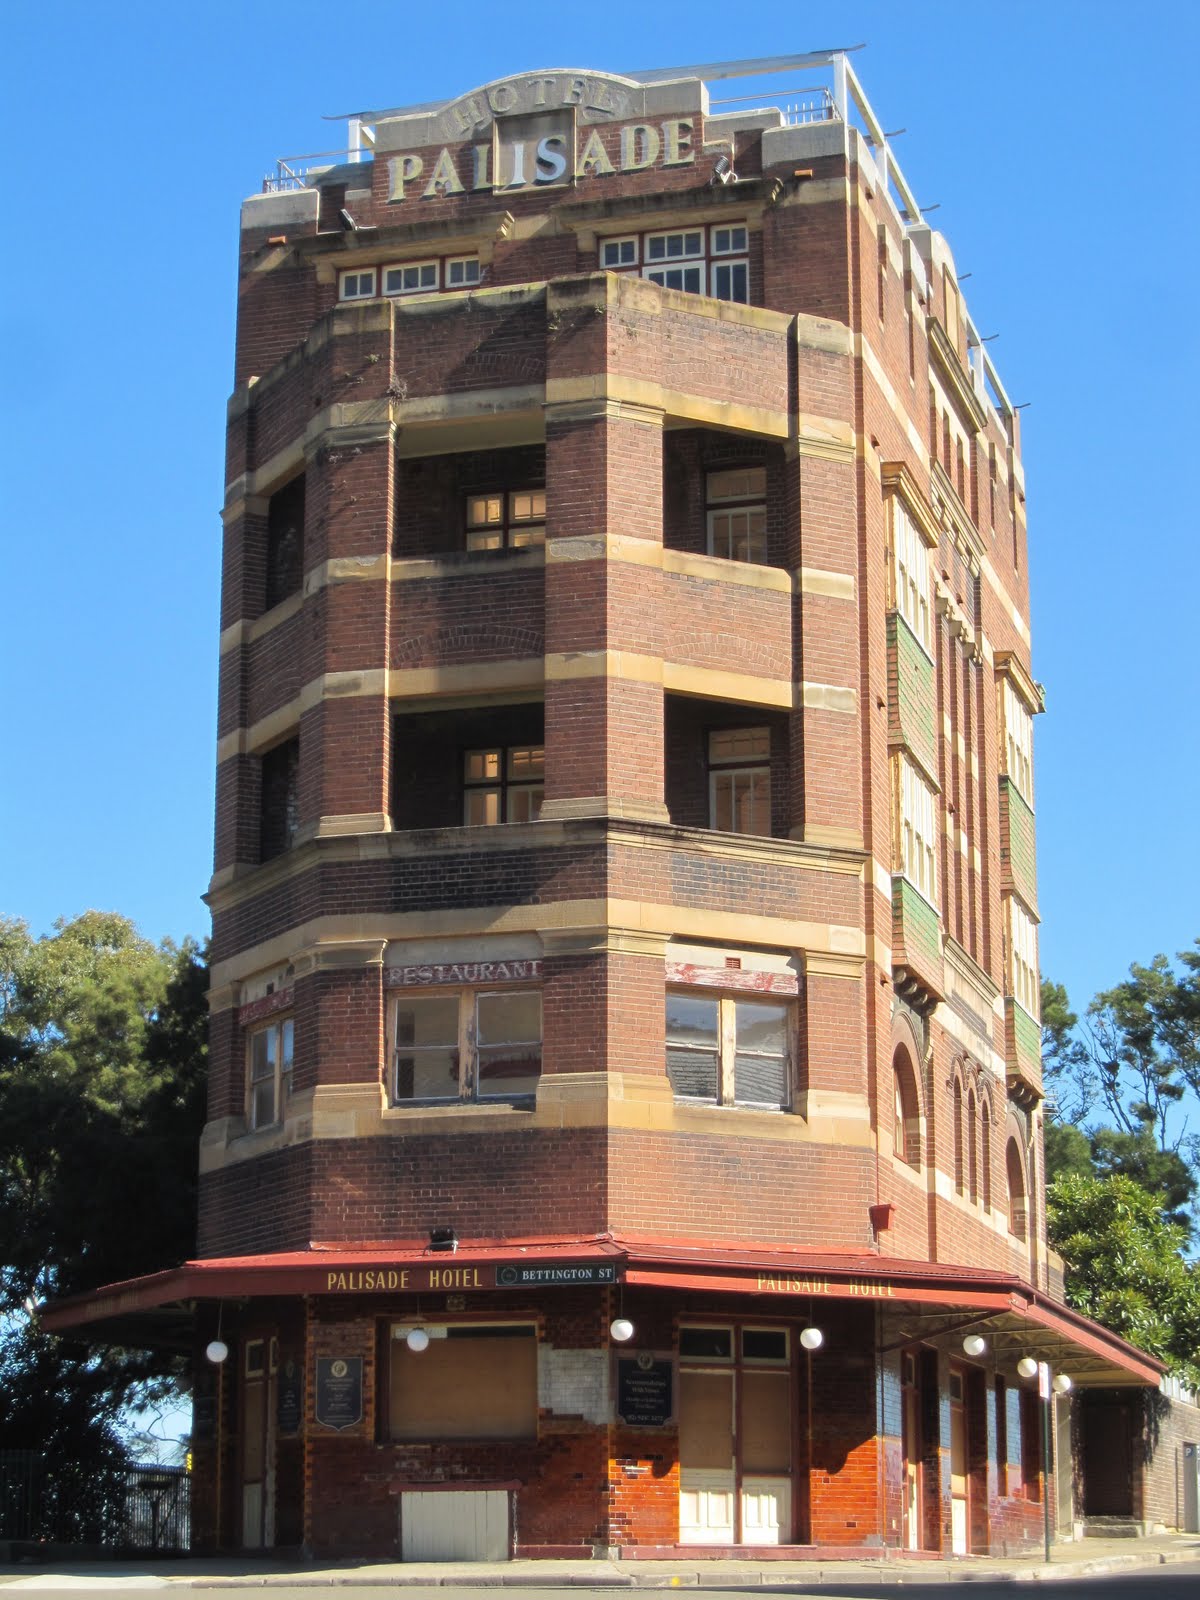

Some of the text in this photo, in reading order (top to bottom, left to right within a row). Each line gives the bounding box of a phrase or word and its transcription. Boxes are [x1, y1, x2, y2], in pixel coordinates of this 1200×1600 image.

[452, 77, 621, 134] HOTEL
[386, 118, 696, 204] PALISADE
[389, 960, 542, 985] RESTAURANT
[327, 1268, 483, 1290] PALISADE HOTEL
[522, 1268, 613, 1280] BETTINGTON ST
[757, 1272, 896, 1297] PALISADE HOTEL
[1185, 1447, 1192, 1457] P
